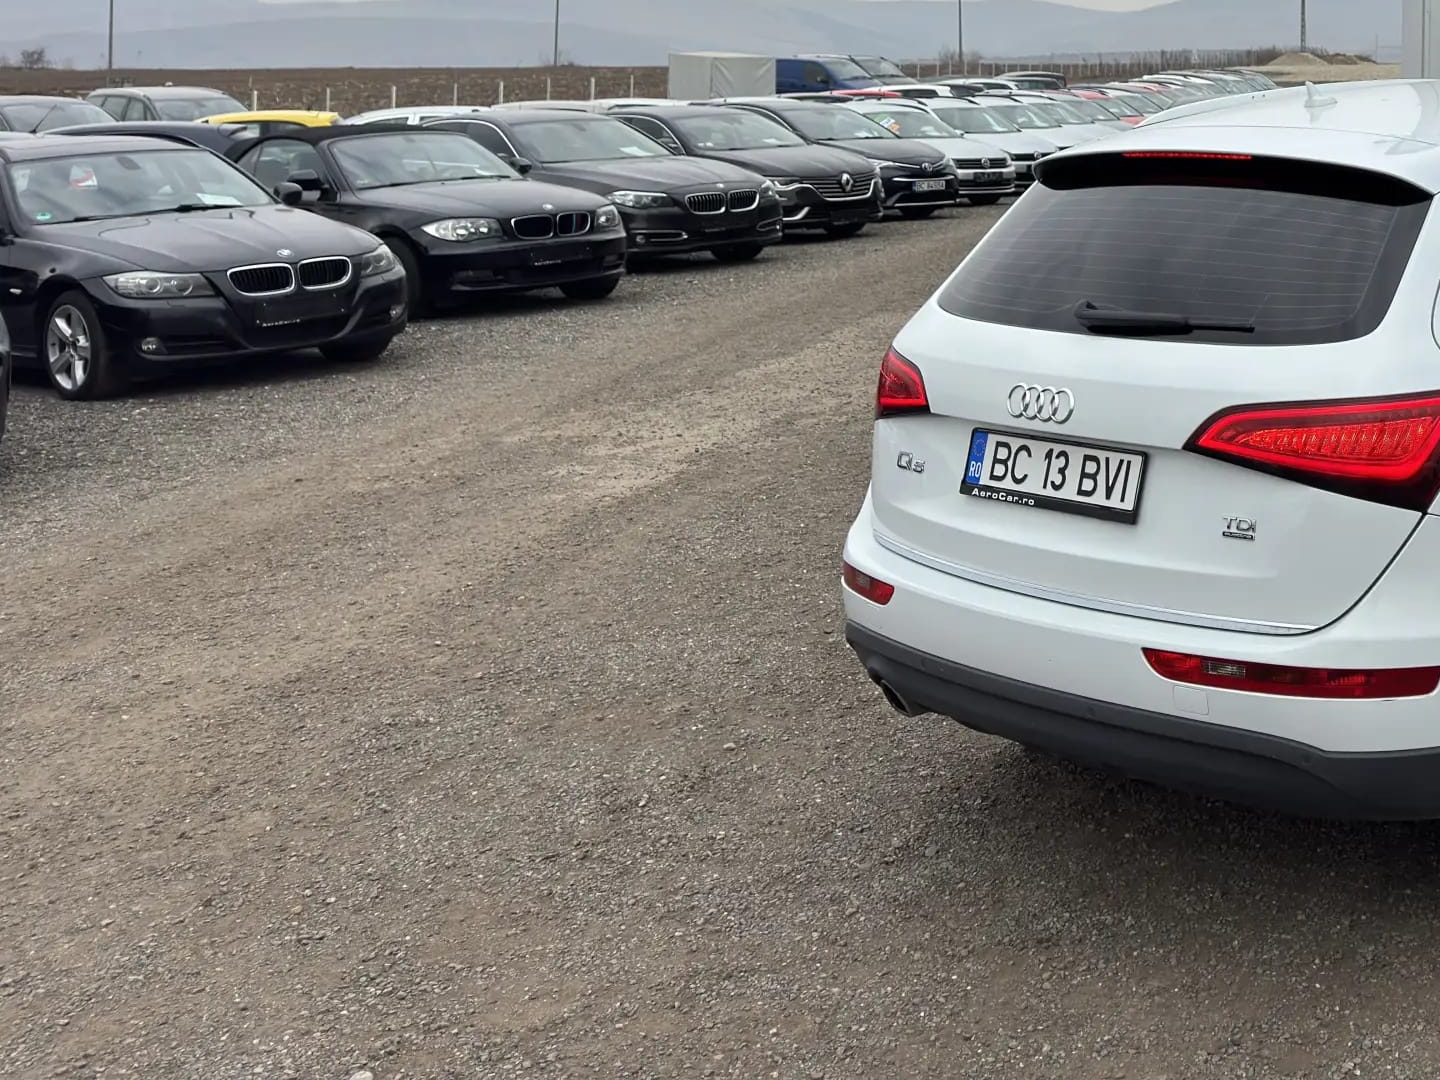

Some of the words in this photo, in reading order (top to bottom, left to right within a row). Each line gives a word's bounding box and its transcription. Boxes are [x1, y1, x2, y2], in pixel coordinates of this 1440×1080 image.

[967, 460, 983, 478] RO
[988, 440, 1032, 485] BC
[1042, 448, 1069, 491] 13
[1076, 454, 1132, 503] BVI
[971, 487, 1035, 507] AeroCar.ro
[1223, 517, 1256, 533] TDI
